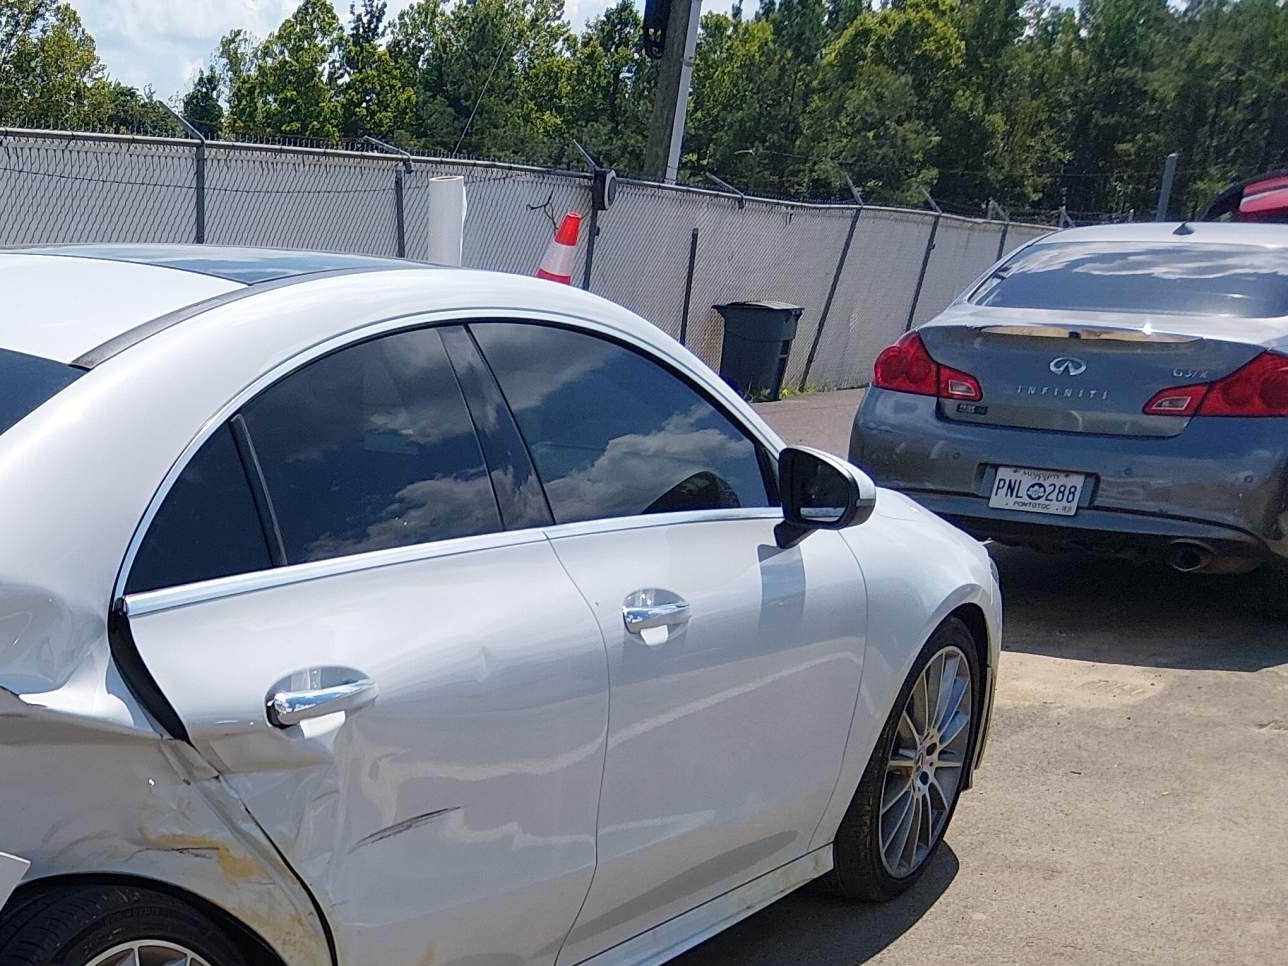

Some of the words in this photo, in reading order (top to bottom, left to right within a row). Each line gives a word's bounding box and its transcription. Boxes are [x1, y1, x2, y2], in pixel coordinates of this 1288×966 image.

[1016, 385, 1109, 400] INFINITI
[994, 478, 1024, 499] PNL
[1045, 483, 1078, 504] 288
[1013, 500, 1052, 511] PONTOTOC
